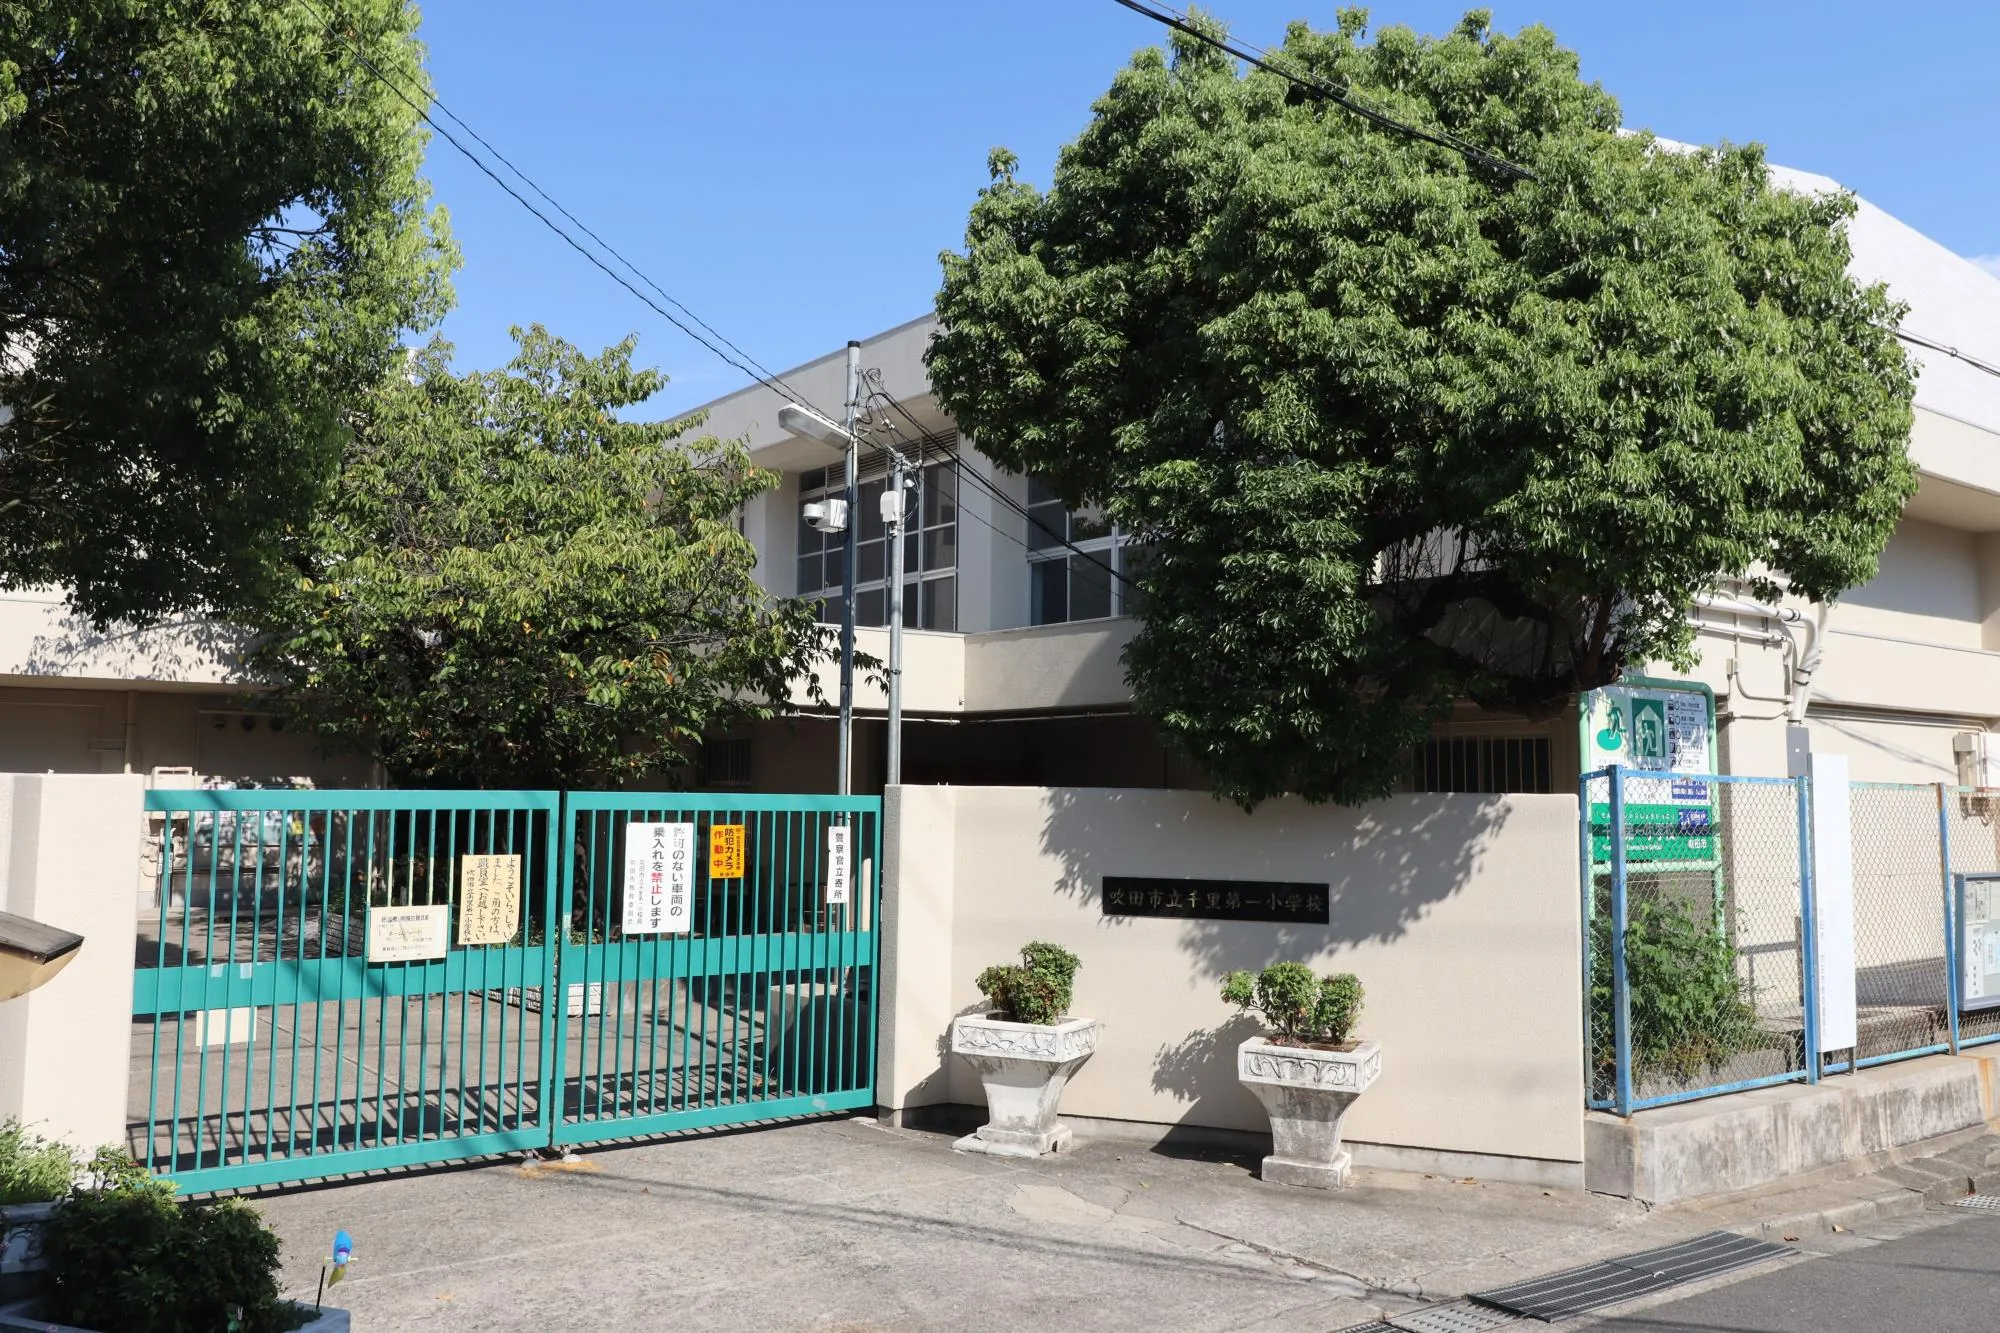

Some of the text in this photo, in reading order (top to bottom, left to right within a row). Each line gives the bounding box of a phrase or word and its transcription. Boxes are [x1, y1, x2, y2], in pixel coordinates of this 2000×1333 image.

[670, 827, 685, 917] 許可のない車両の
[713, 829, 724, 869] 作動中
[724, 828, 734, 871] 防犯カメラ
[834, 832, 844, 899] 警察官立寄所
[650, 827, 664, 928] 乗入れを禁止します
[1110, 888, 1323, 913] 吹田市立千里第一小学校
